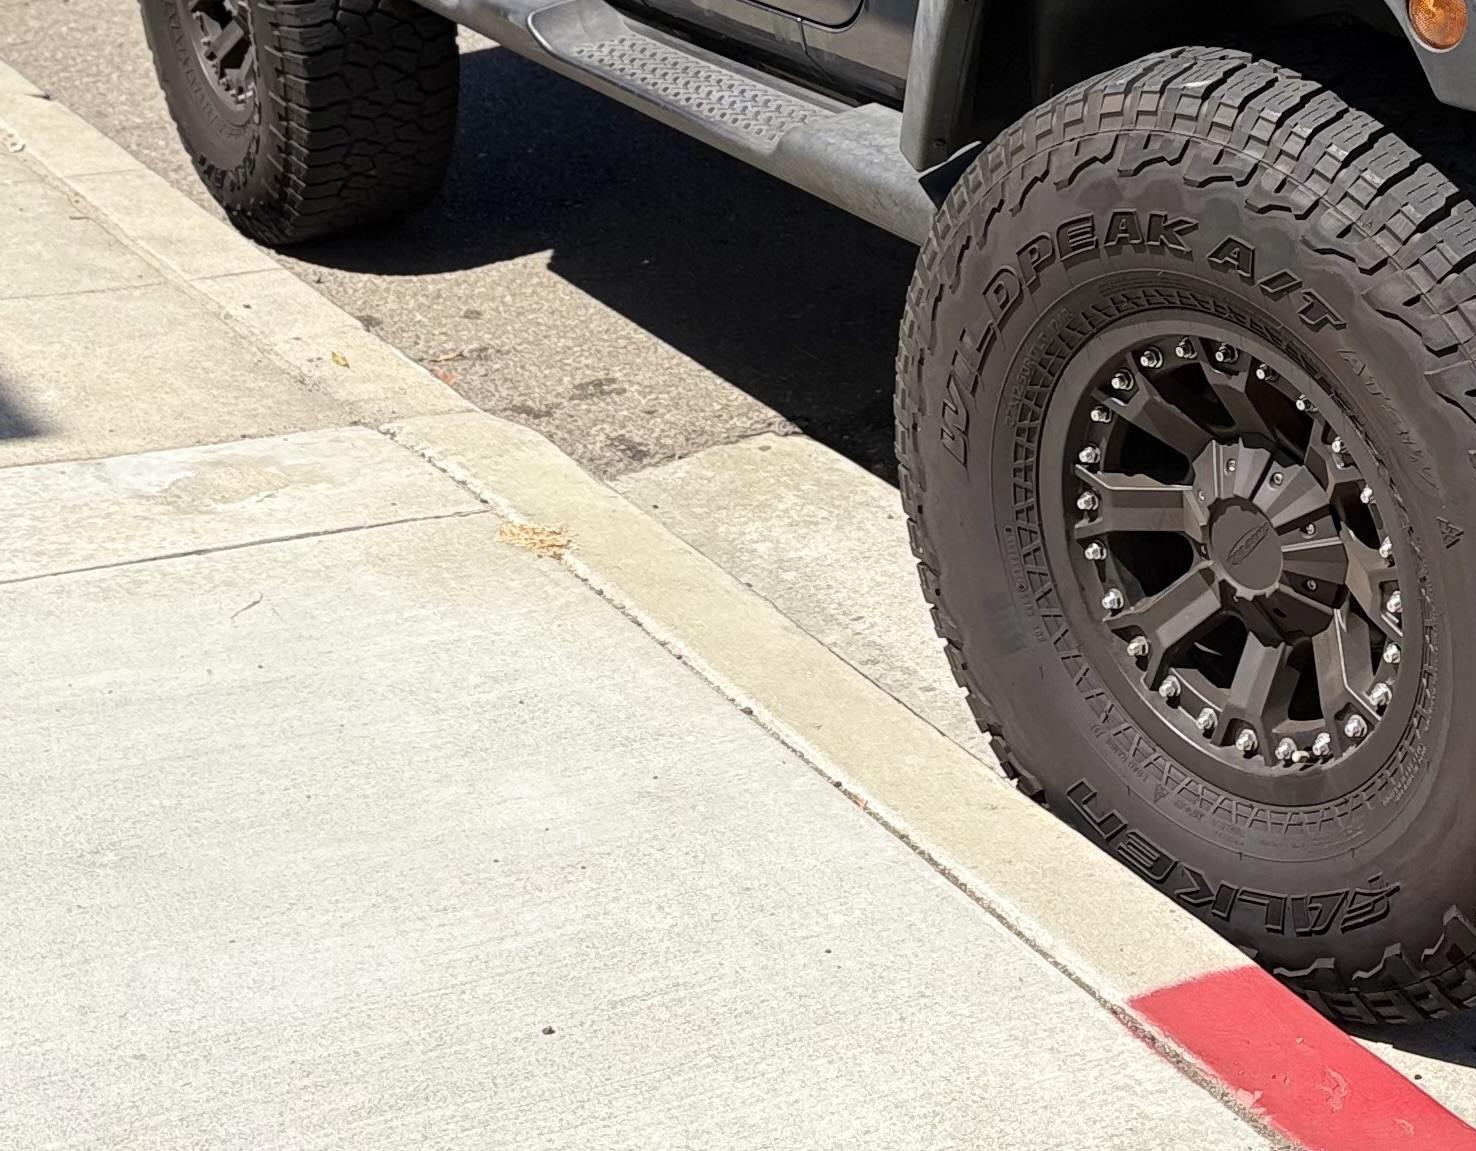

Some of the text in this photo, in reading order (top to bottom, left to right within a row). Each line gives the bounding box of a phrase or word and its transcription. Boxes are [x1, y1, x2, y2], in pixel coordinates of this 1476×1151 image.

[940, 208, 1347, 465] WILDPEAK A/T
[1066, 777, 1401, 936] FALKEN
